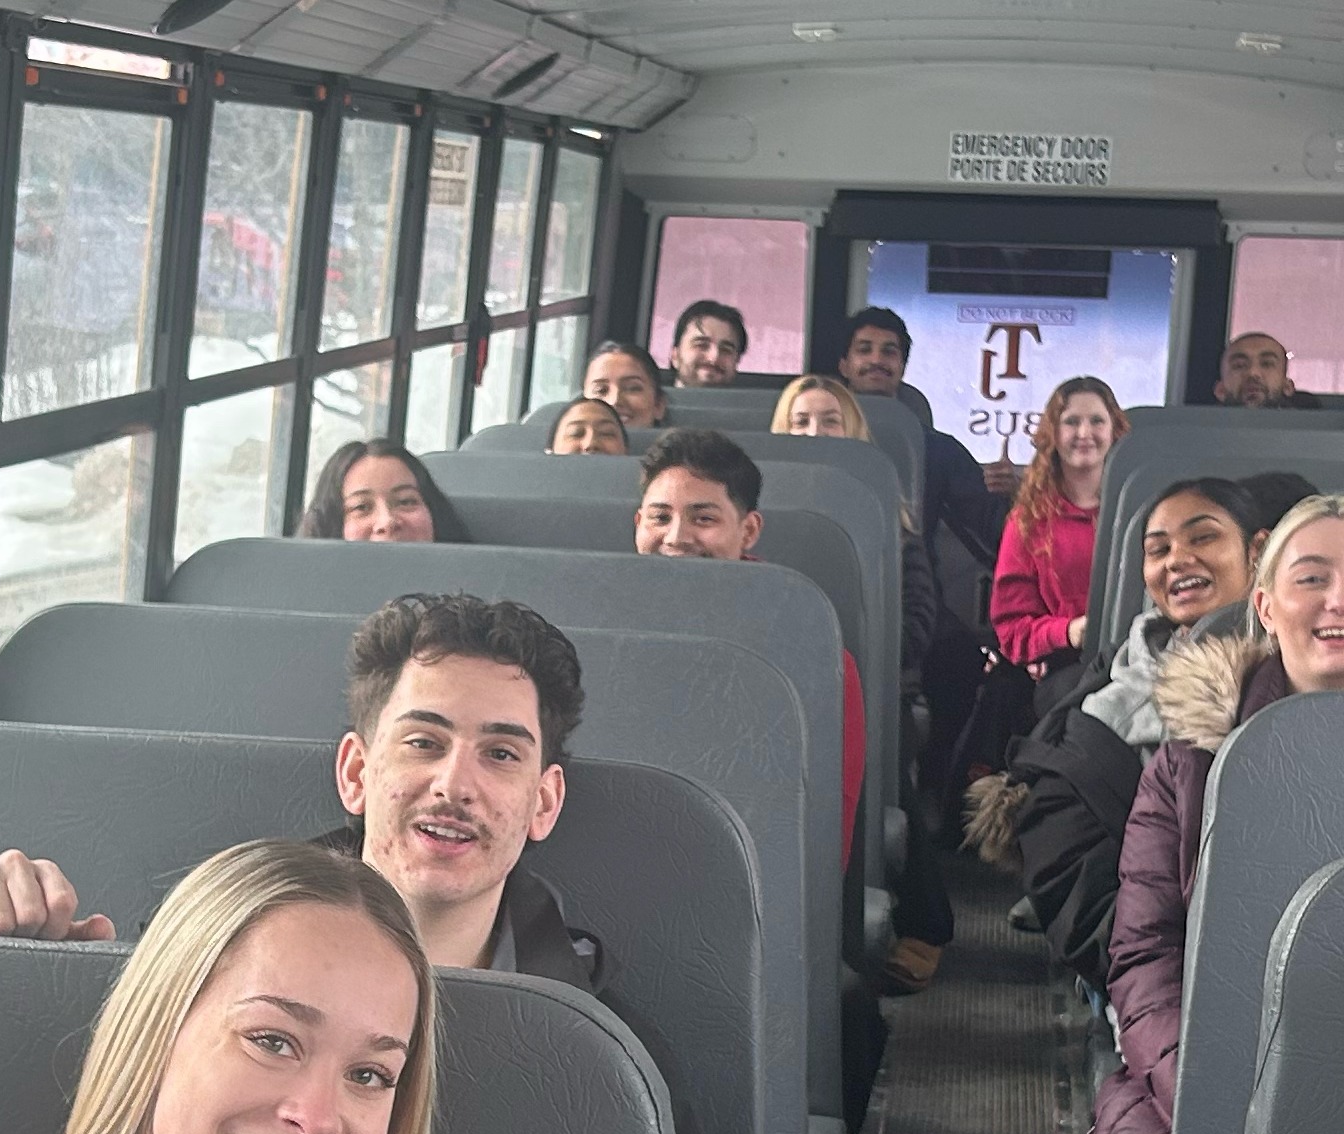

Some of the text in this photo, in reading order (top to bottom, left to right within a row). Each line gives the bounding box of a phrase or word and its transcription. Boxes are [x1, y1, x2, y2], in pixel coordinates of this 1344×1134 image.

[952, 134, 1110, 160] EMERGENCY DOOR
[950, 158, 1109, 185] PORTE DE SECOURS
